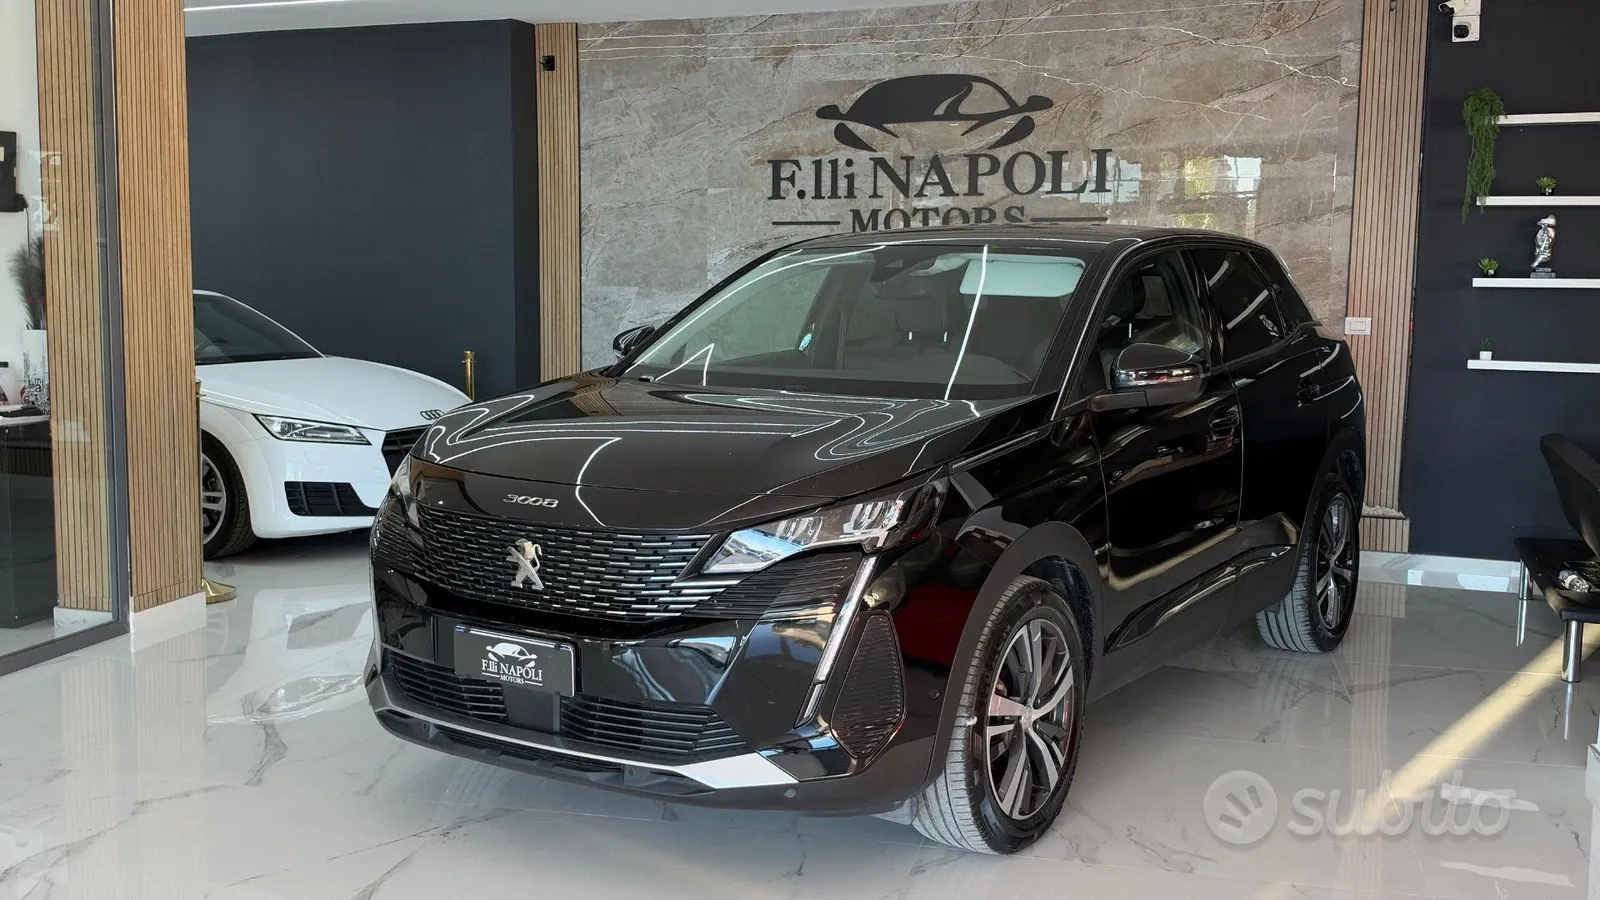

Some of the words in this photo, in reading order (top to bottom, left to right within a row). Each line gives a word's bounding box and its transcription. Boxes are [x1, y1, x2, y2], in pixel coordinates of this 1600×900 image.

[767, 158, 857, 200] F.lli
[869, 149, 1113, 199] NAPOLI
[503, 494, 559, 508] 3008
[481, 659, 498, 673] F.lli
[500, 662, 543, 681] NAPOLI
[500, 674, 524, 684] MOTORS
